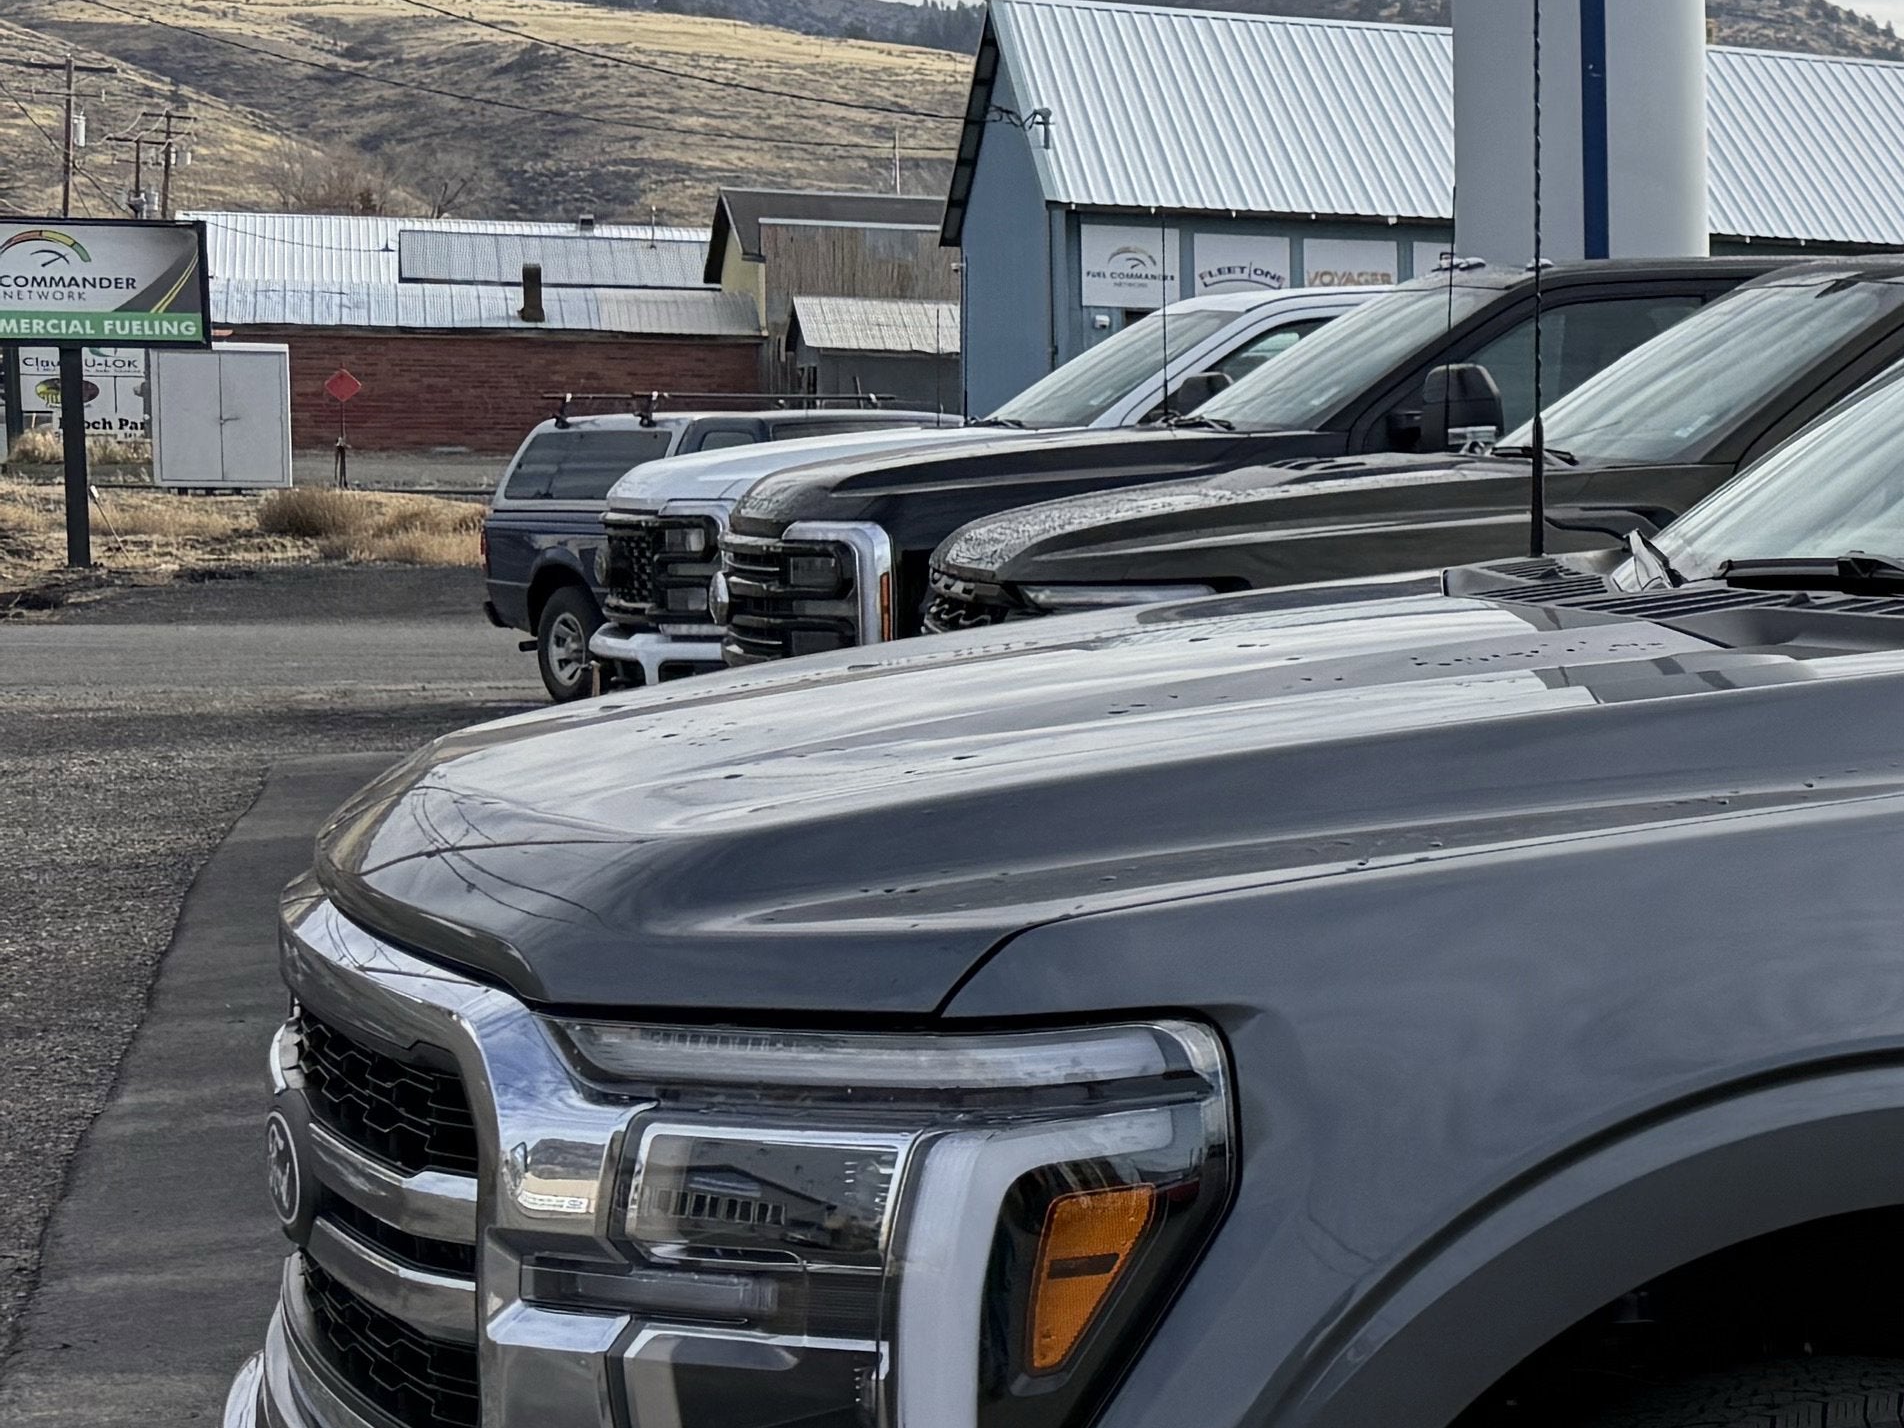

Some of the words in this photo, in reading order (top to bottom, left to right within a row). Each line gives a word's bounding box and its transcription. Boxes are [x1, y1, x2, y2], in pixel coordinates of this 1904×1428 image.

[0, 275, 138, 290] COMMANDER
[1199, 266, 1247, 281] FLEET
[1253, 267, 1286, 284] ONE
[1307, 270, 1393, 286] VOYAGER
[3, 290, 87, 302] NETWORK
[0, 319, 95, 335] MERCIAL
[103, 320, 197, 336] FUELING
